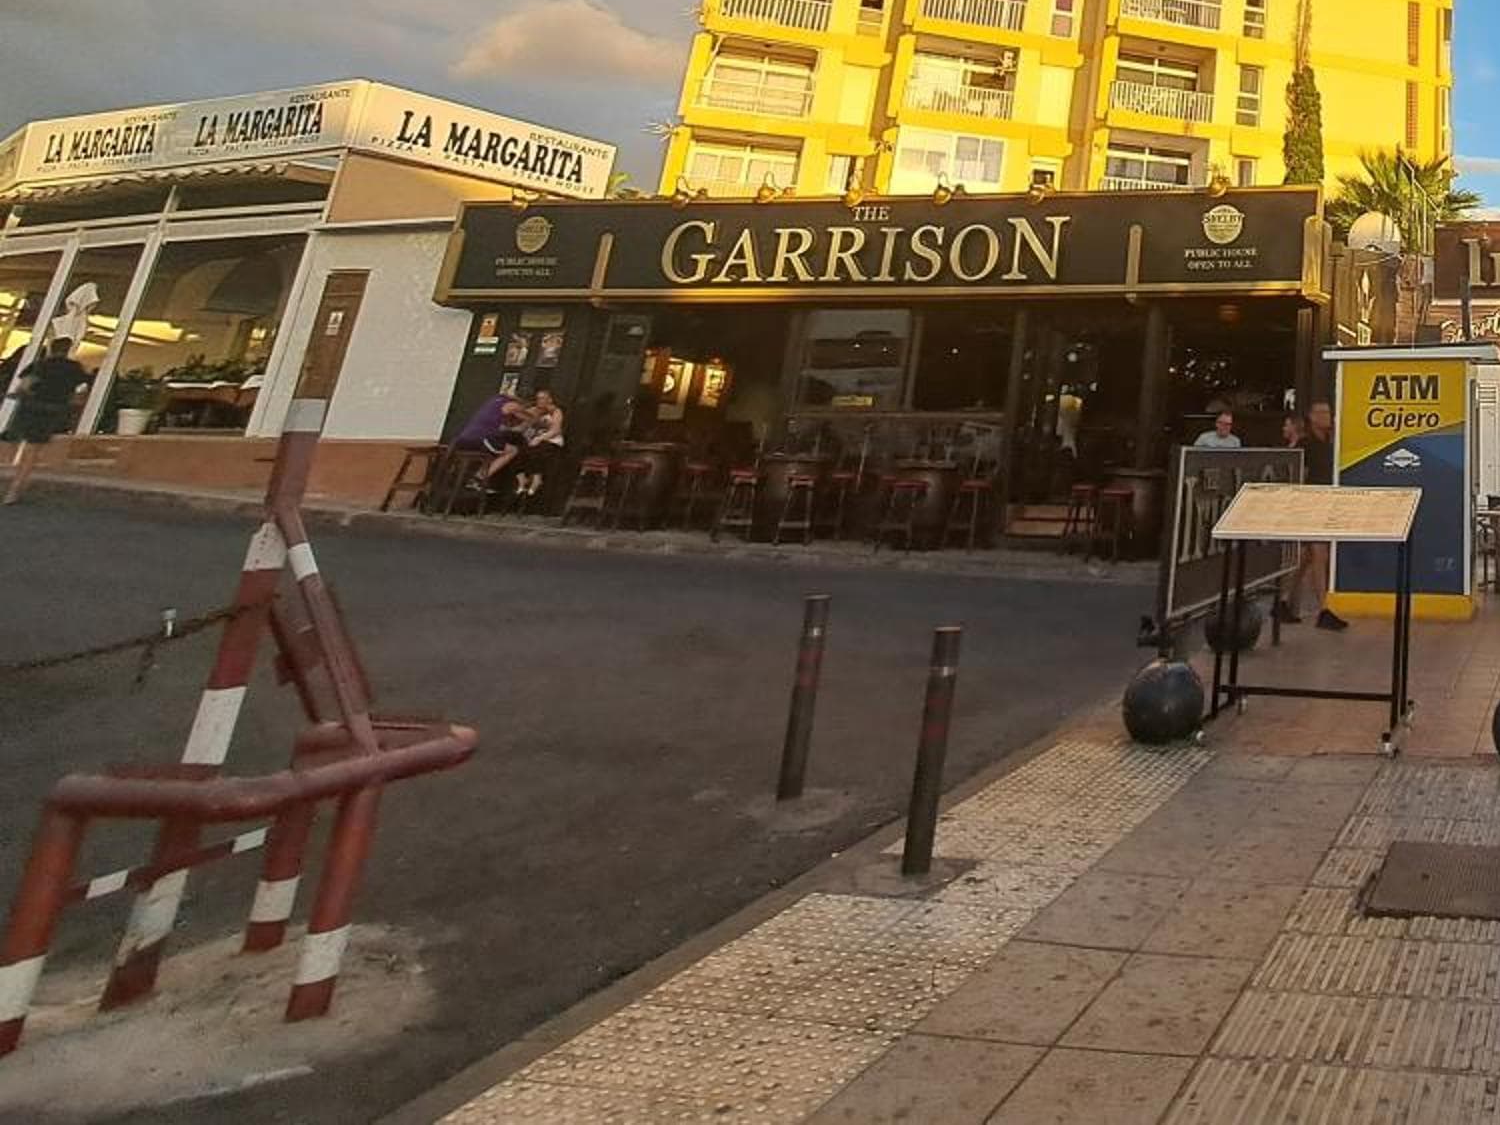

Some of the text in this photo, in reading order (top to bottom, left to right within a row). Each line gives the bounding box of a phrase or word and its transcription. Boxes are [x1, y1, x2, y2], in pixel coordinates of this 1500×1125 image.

[194, 102, 323, 147] LA MARGARITA
[43, 123, 157, 164] LA MARGARITA
[396, 110, 584, 183] LA MARGARITA
[529, 132, 609, 160] RESTAURANTE
[371, 136, 595, 194] PIZZA PASTA STEAK HOUSE
[853, 206, 890, 222] THE
[661, 216, 1072, 284] GARRISON
[1217, 260, 1231, 269] TO
[1369, 374, 1439, 401] ATM
[1367, 406, 1439, 432] Cajero
